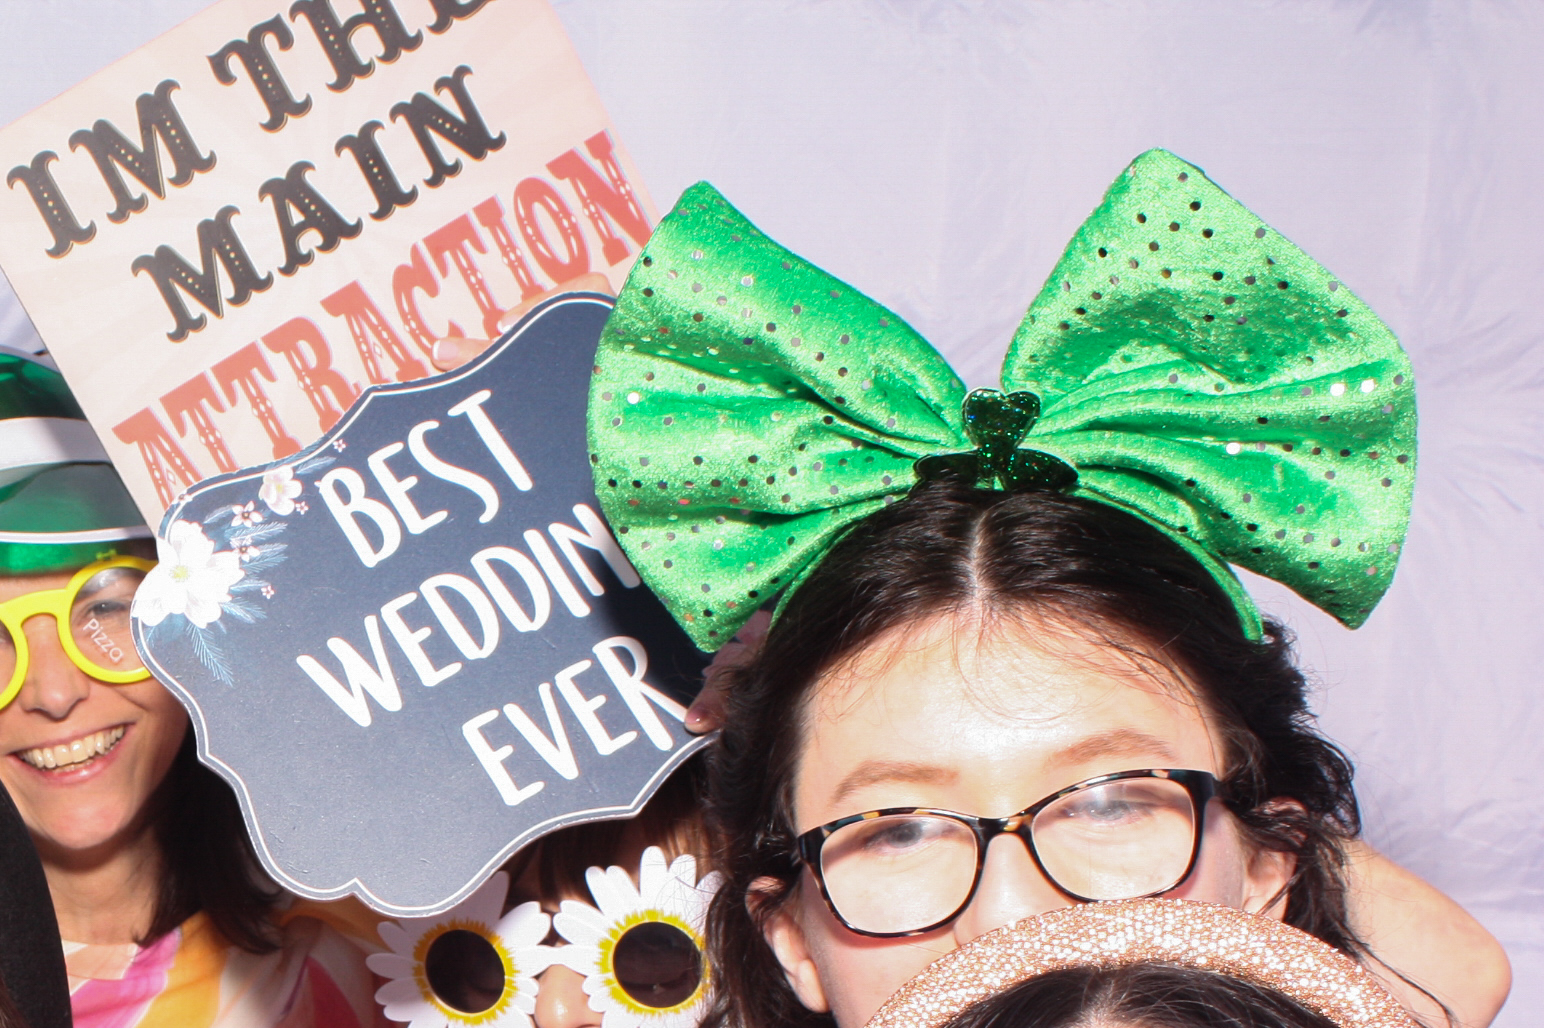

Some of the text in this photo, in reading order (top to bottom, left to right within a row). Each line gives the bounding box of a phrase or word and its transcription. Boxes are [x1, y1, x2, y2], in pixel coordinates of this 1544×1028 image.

[6, 78, 217, 259] IM
[131, 64, 507, 342] MAIN
[111, 128, 659, 508] ATTRACTION
[318, 389, 533, 568] BEST
[82, 617, 125, 663] Pizza
[296, 503, 641, 727] WEDDIN
[462, 636, 688, 806] EVER
